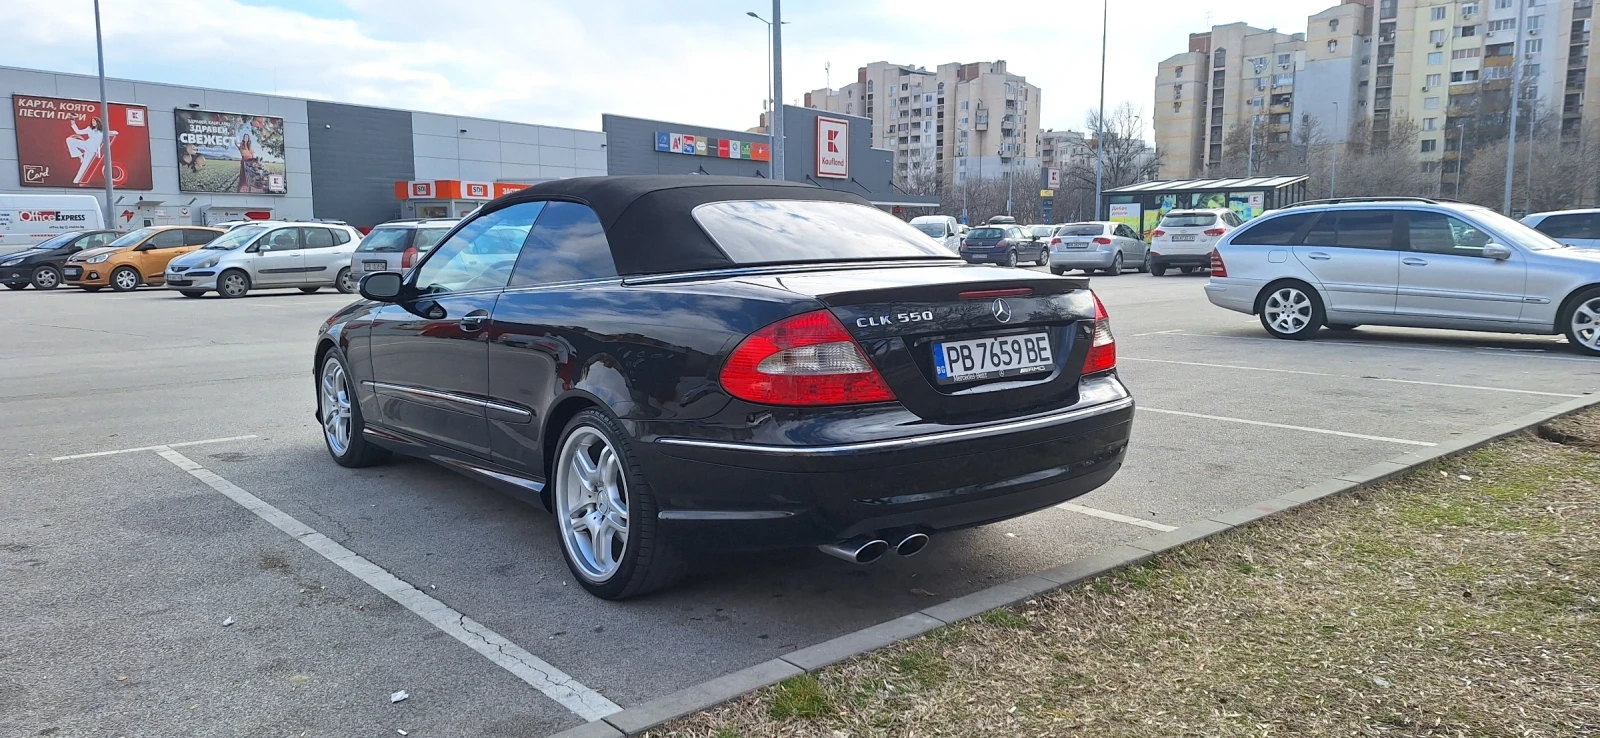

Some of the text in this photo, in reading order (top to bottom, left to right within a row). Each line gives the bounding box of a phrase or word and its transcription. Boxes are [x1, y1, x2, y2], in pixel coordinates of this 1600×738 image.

[18, 98, 95, 113] КАРТА, КОЯТО
[19, 108, 55, 119] ПЕСТИ
[190, 124, 230, 135] ЗДРАВЕЙ,
[180, 132, 237, 147] СВЕЖЕСТ
[822, 157, 844, 167] Kaufland
[27, 166, 50, 181] Card
[856, 311, 933, 328] CLK 550
[946, 336, 1051, 373] PB 7659 BE
[936, 365, 946, 375] BG
[953, 372, 988, 382] Mercedes-Benz
